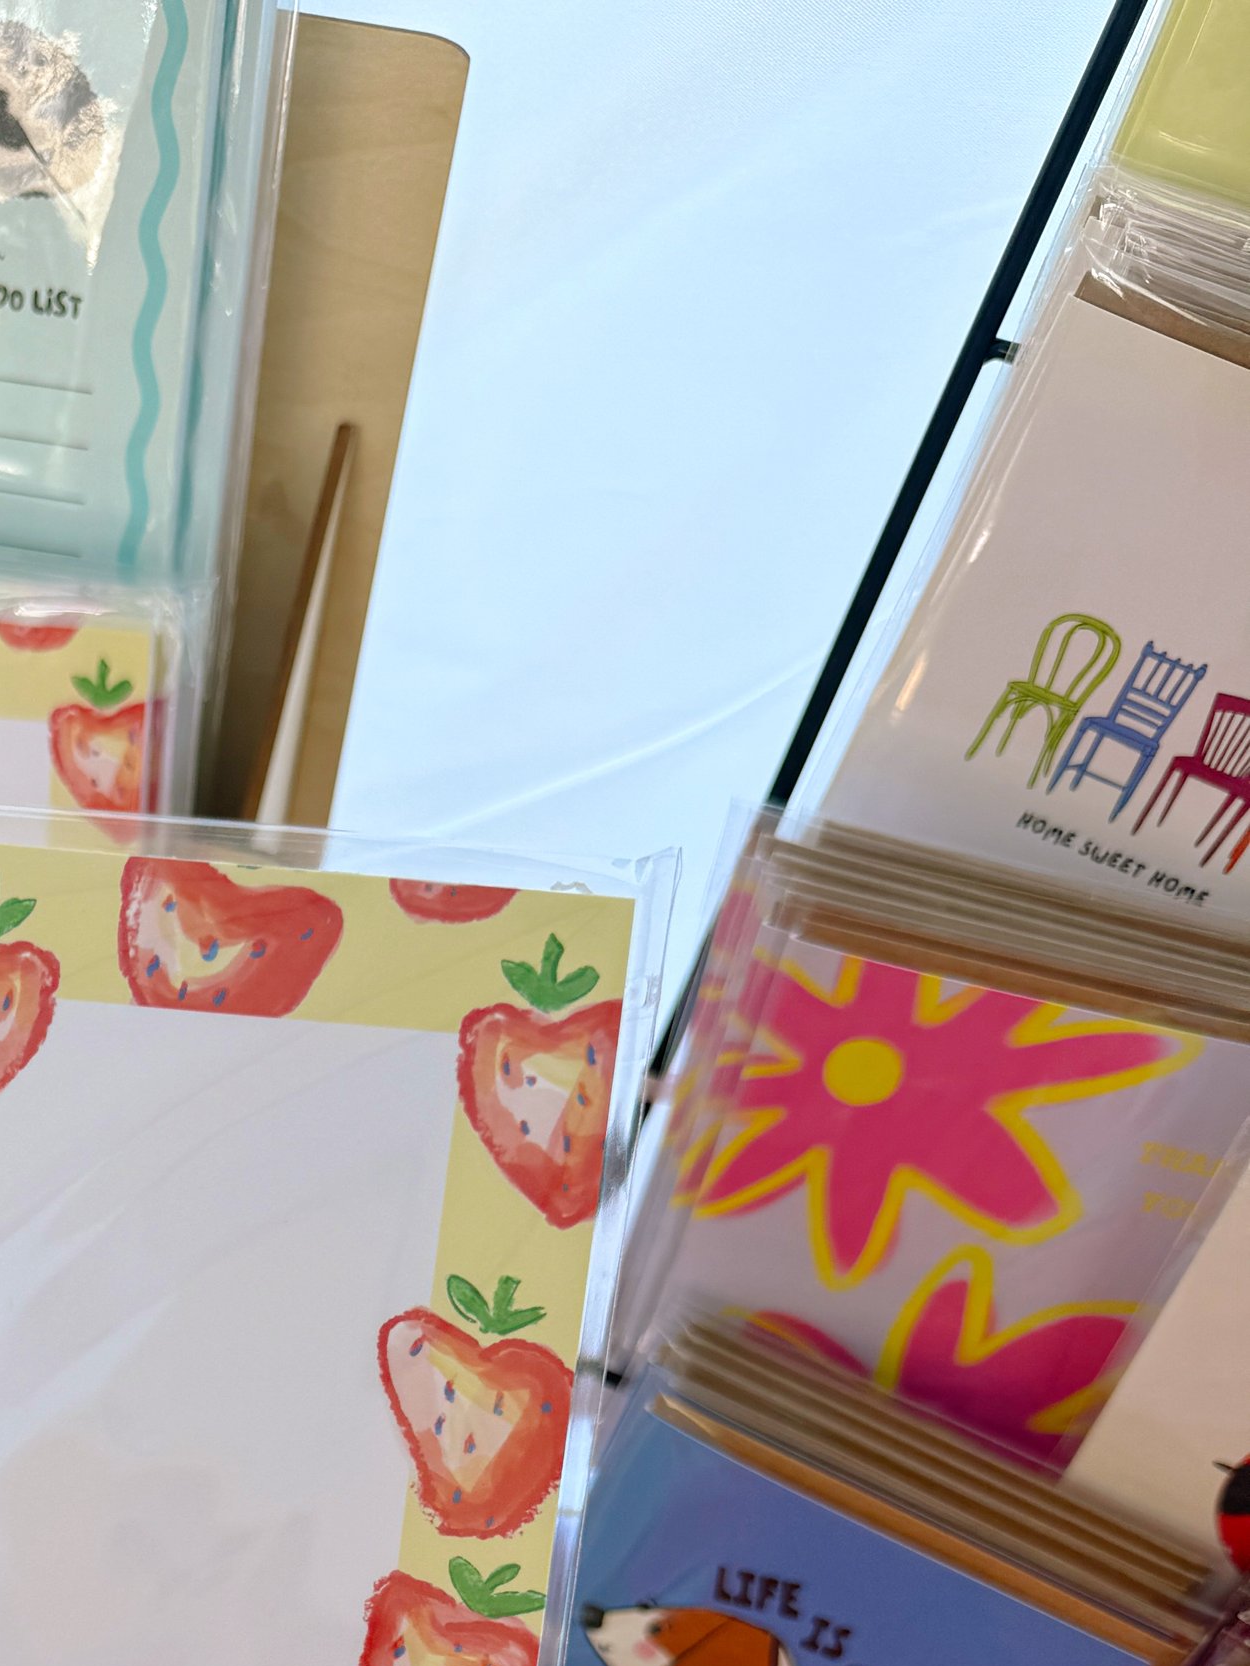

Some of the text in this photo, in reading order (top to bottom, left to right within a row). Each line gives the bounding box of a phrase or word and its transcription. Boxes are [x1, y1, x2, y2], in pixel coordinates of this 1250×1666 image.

[1015, 811, 1213, 908] HOME SWEET HOME
[713, 1566, 803, 1618] LIFE
[800, 1616, 853, 1659] IS
